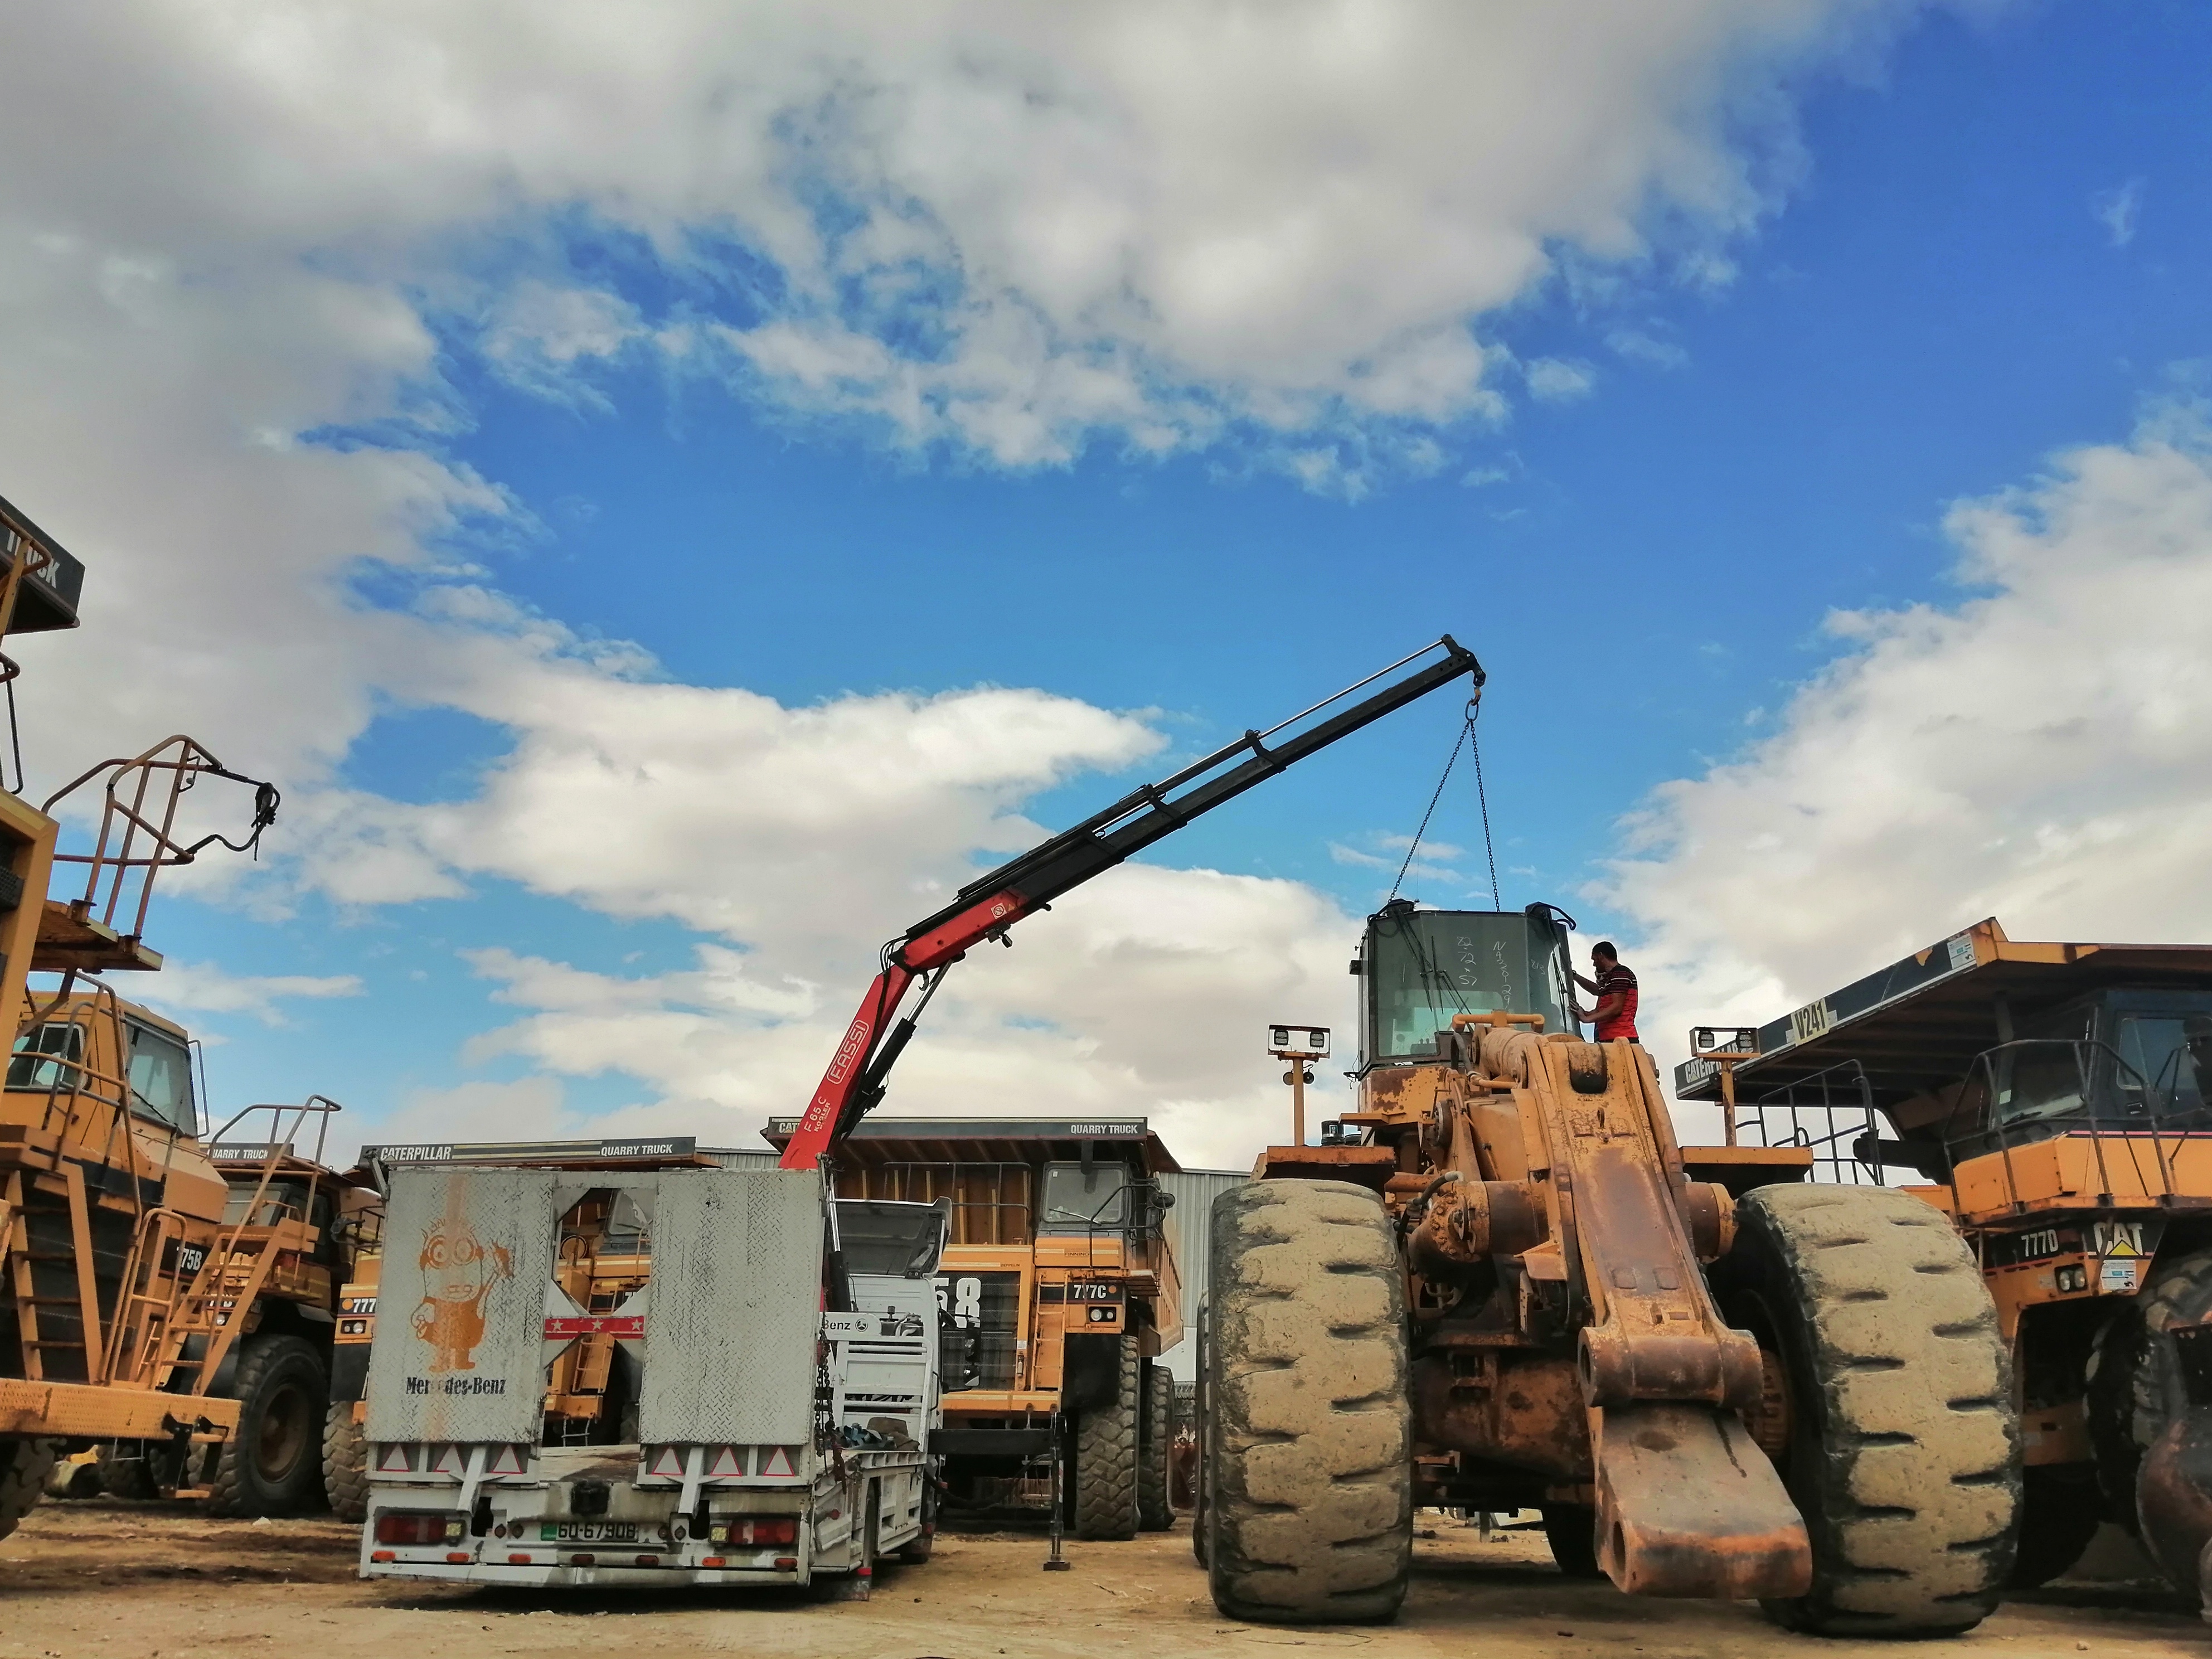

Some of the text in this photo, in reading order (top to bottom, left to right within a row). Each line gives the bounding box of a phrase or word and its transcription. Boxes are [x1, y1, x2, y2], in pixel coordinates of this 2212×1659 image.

[7, 527, 60, 589] TUCK
[1794, 1001, 1826, 1040] V241
[830, 1025, 866, 1080] FASSI
[1070, 1124, 1138, 1134] QUARRY TRUCK
[207, 1148, 240, 1159] UARRY
[380, 1146, 452, 1161] CATERPILLAR
[601, 1144, 673, 1157] QUARRY TRUCK
[2021, 1229, 2059, 1257] 777D
[2093, 1222, 2143, 1256] CAT
[176, 1246, 202, 1270] 75B
[406, 1377, 506, 1395] Merdes-Benz
[558, 1523, 636, 1539] 60-67908
